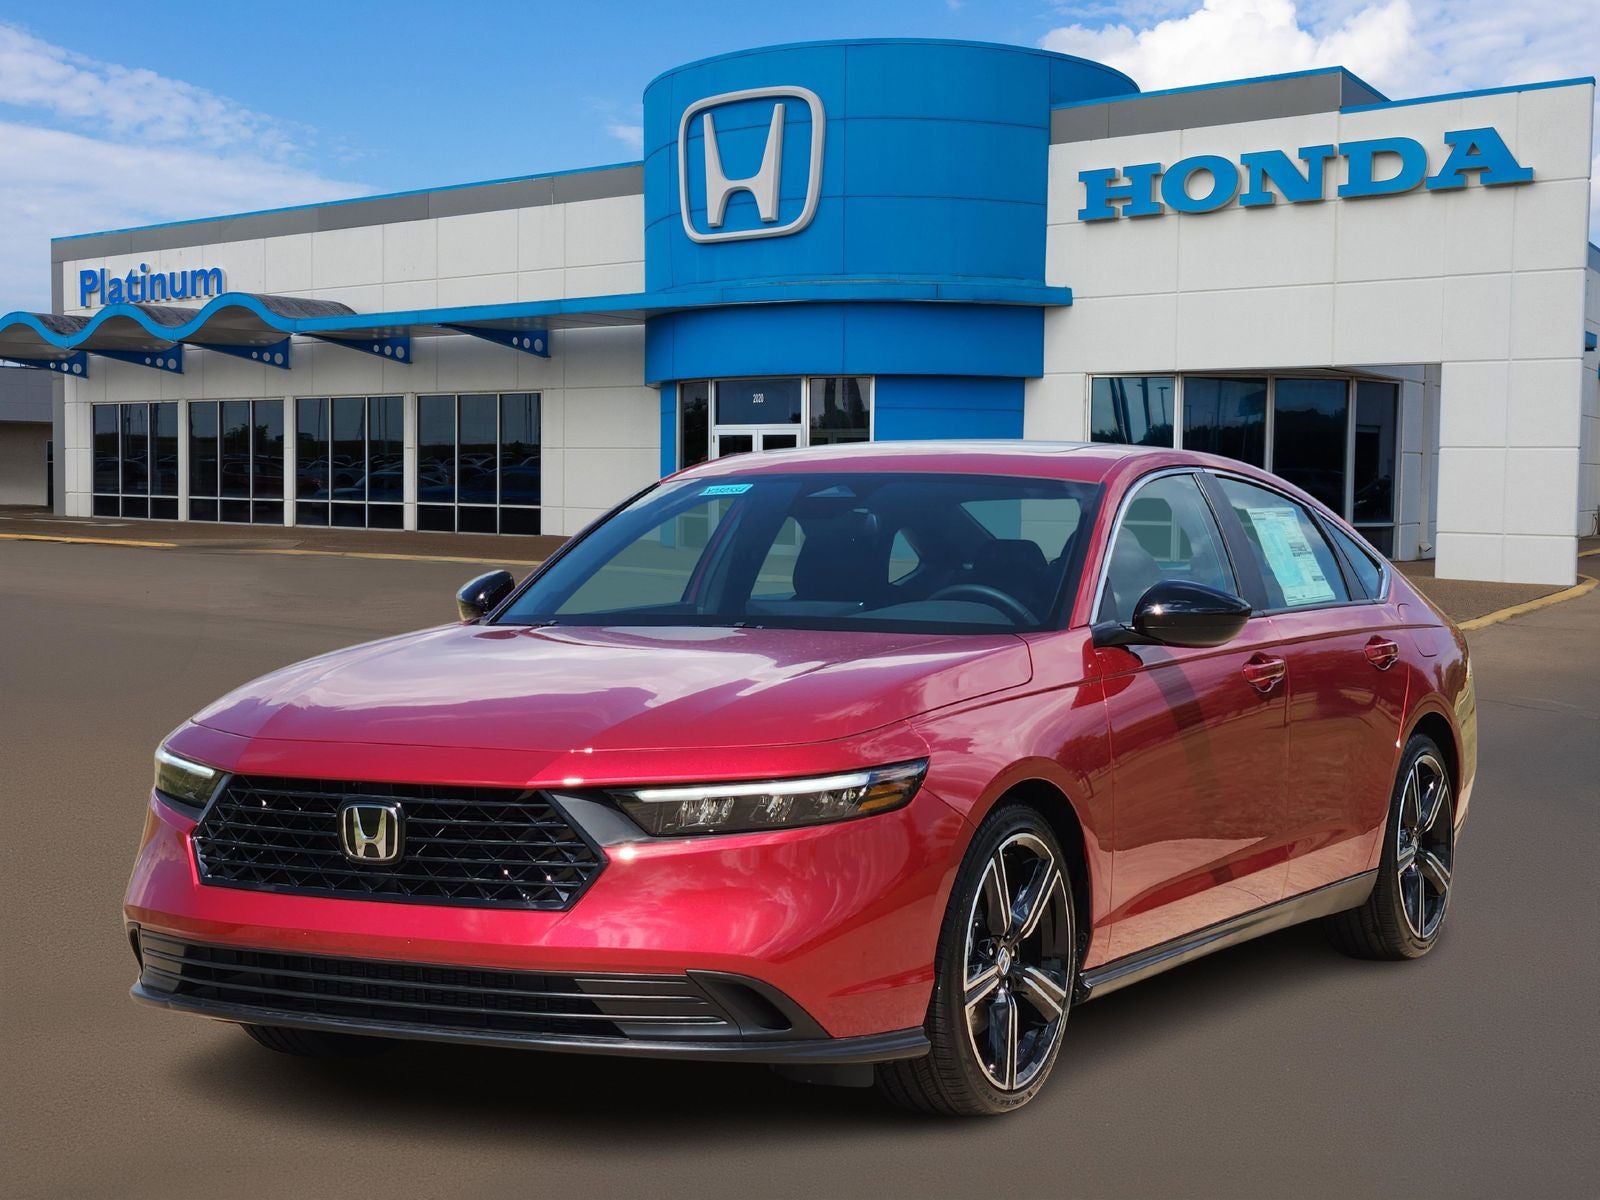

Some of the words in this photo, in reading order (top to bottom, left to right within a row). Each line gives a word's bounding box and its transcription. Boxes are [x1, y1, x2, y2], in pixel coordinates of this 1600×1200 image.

[703, 103, 785, 227] H
[1078, 126, 1534, 222] HONDA
[79, 262, 226, 307] Platinum
[752, 392, 764, 404] 2020
